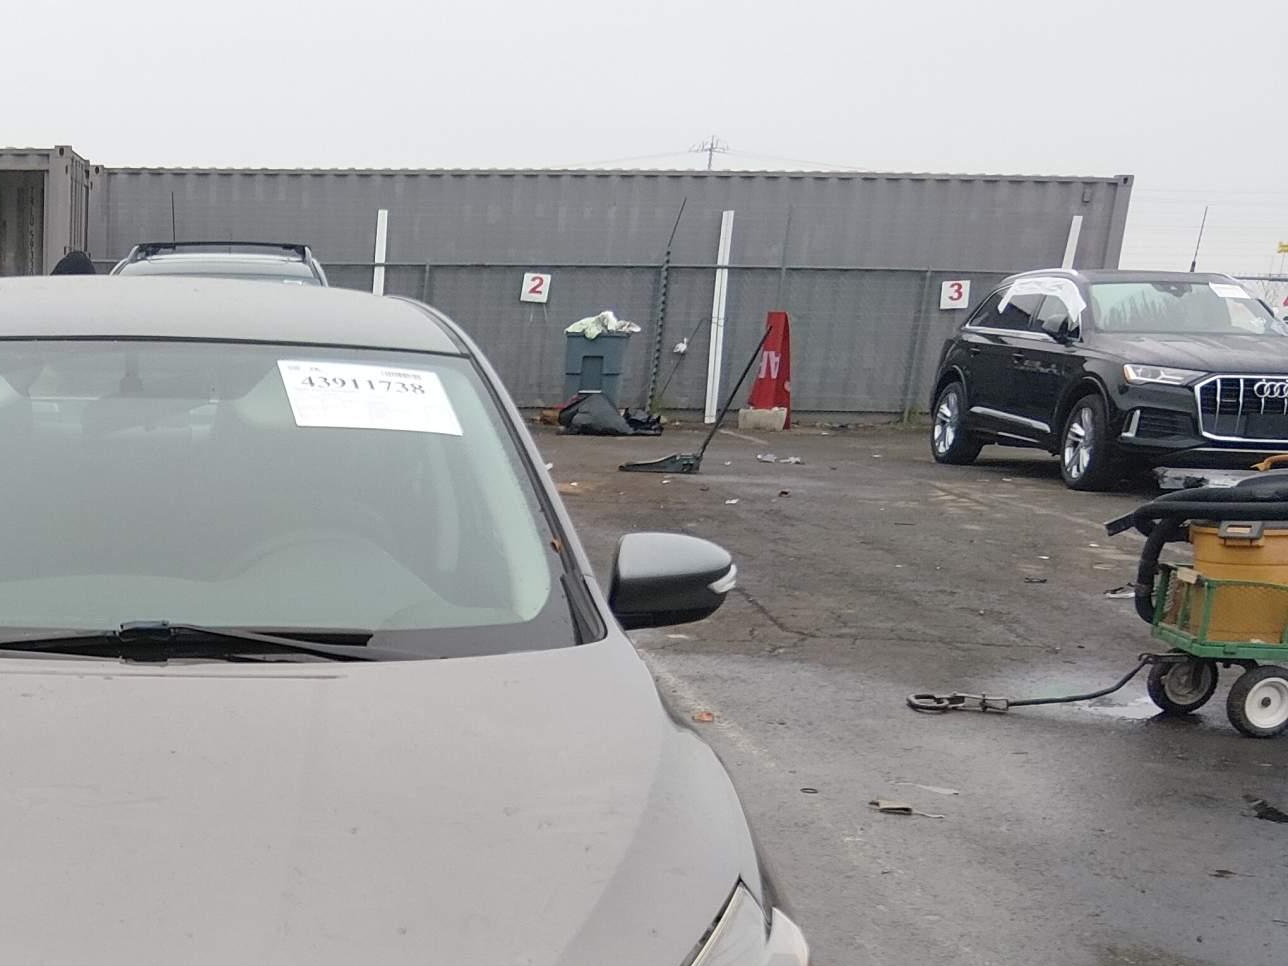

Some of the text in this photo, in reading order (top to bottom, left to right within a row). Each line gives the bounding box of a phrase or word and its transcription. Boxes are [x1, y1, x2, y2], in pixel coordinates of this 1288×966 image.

[528, 276, 544, 295] 2
[948, 282, 963, 301] 3
[300, 375, 425, 394] 43911738
